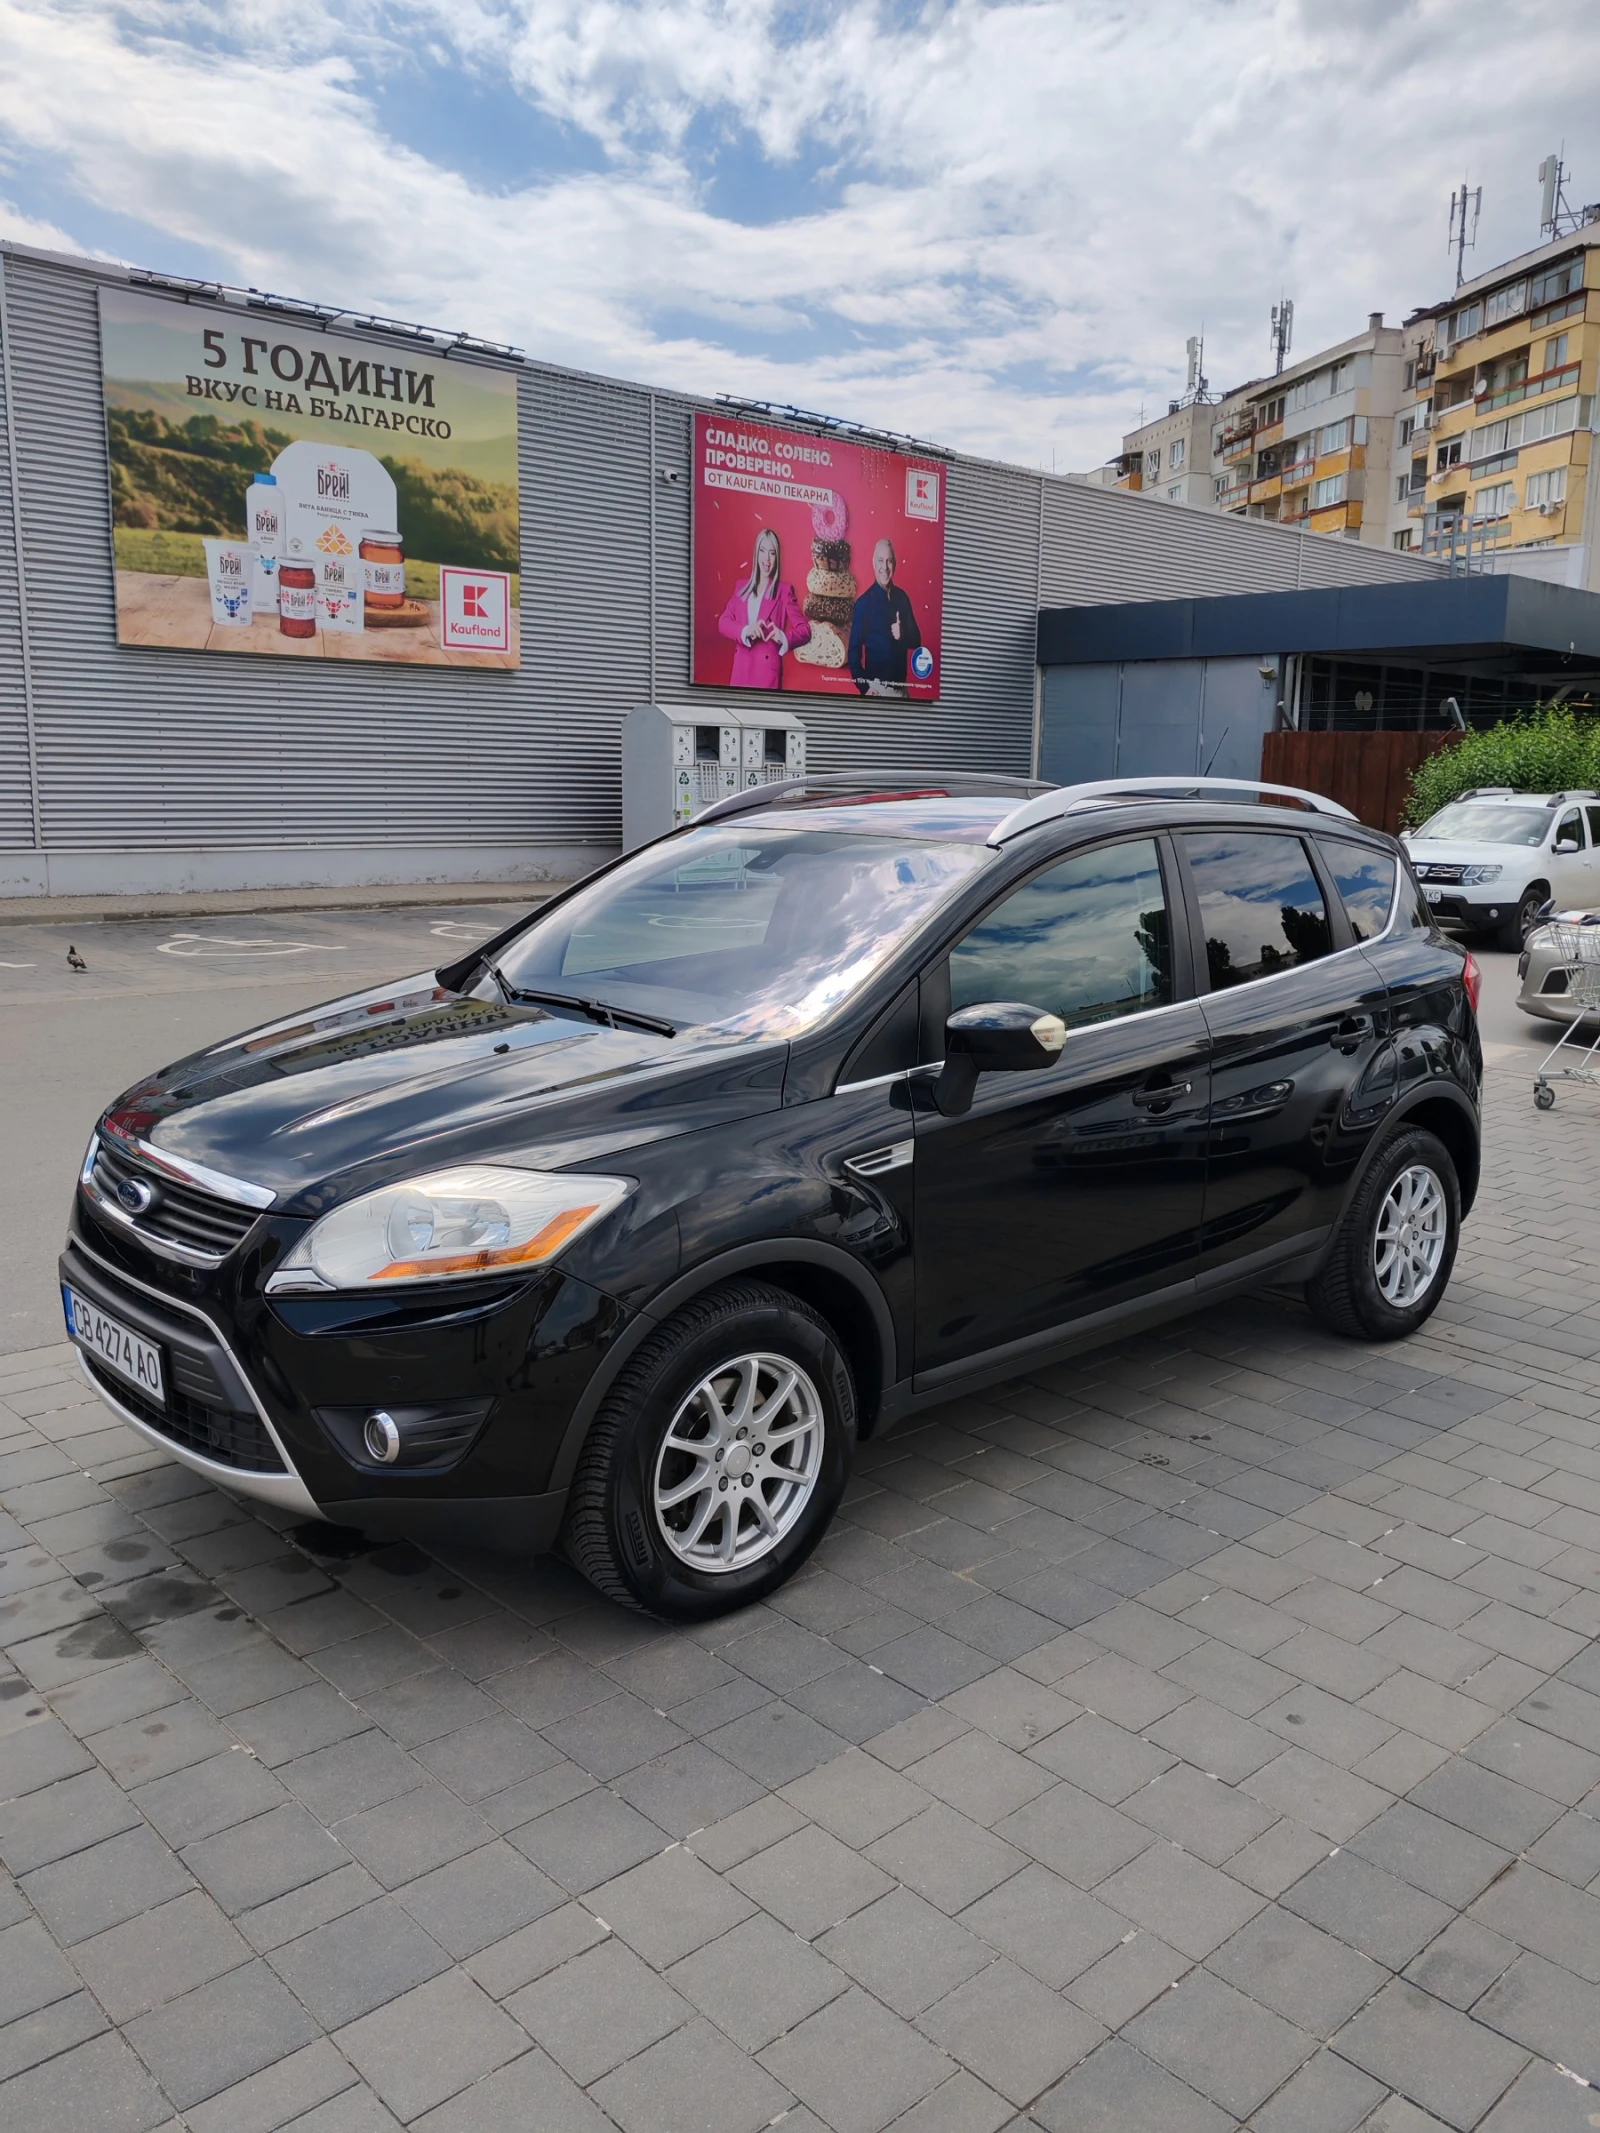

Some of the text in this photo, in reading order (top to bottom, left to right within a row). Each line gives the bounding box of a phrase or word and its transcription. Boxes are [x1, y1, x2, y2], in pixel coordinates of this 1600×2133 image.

[203, 328, 437, 408] 5 ГОДИНИ
[185, 375, 452, 440] ВКУС НА БЪЛГАРСКО
[705, 448, 795, 479] ПРОВЕРЕНО.
[708, 472, 830, 503] ОТ KAUFLAND ПЕКАРНА
[451, 622, 501, 637] Kaufland
